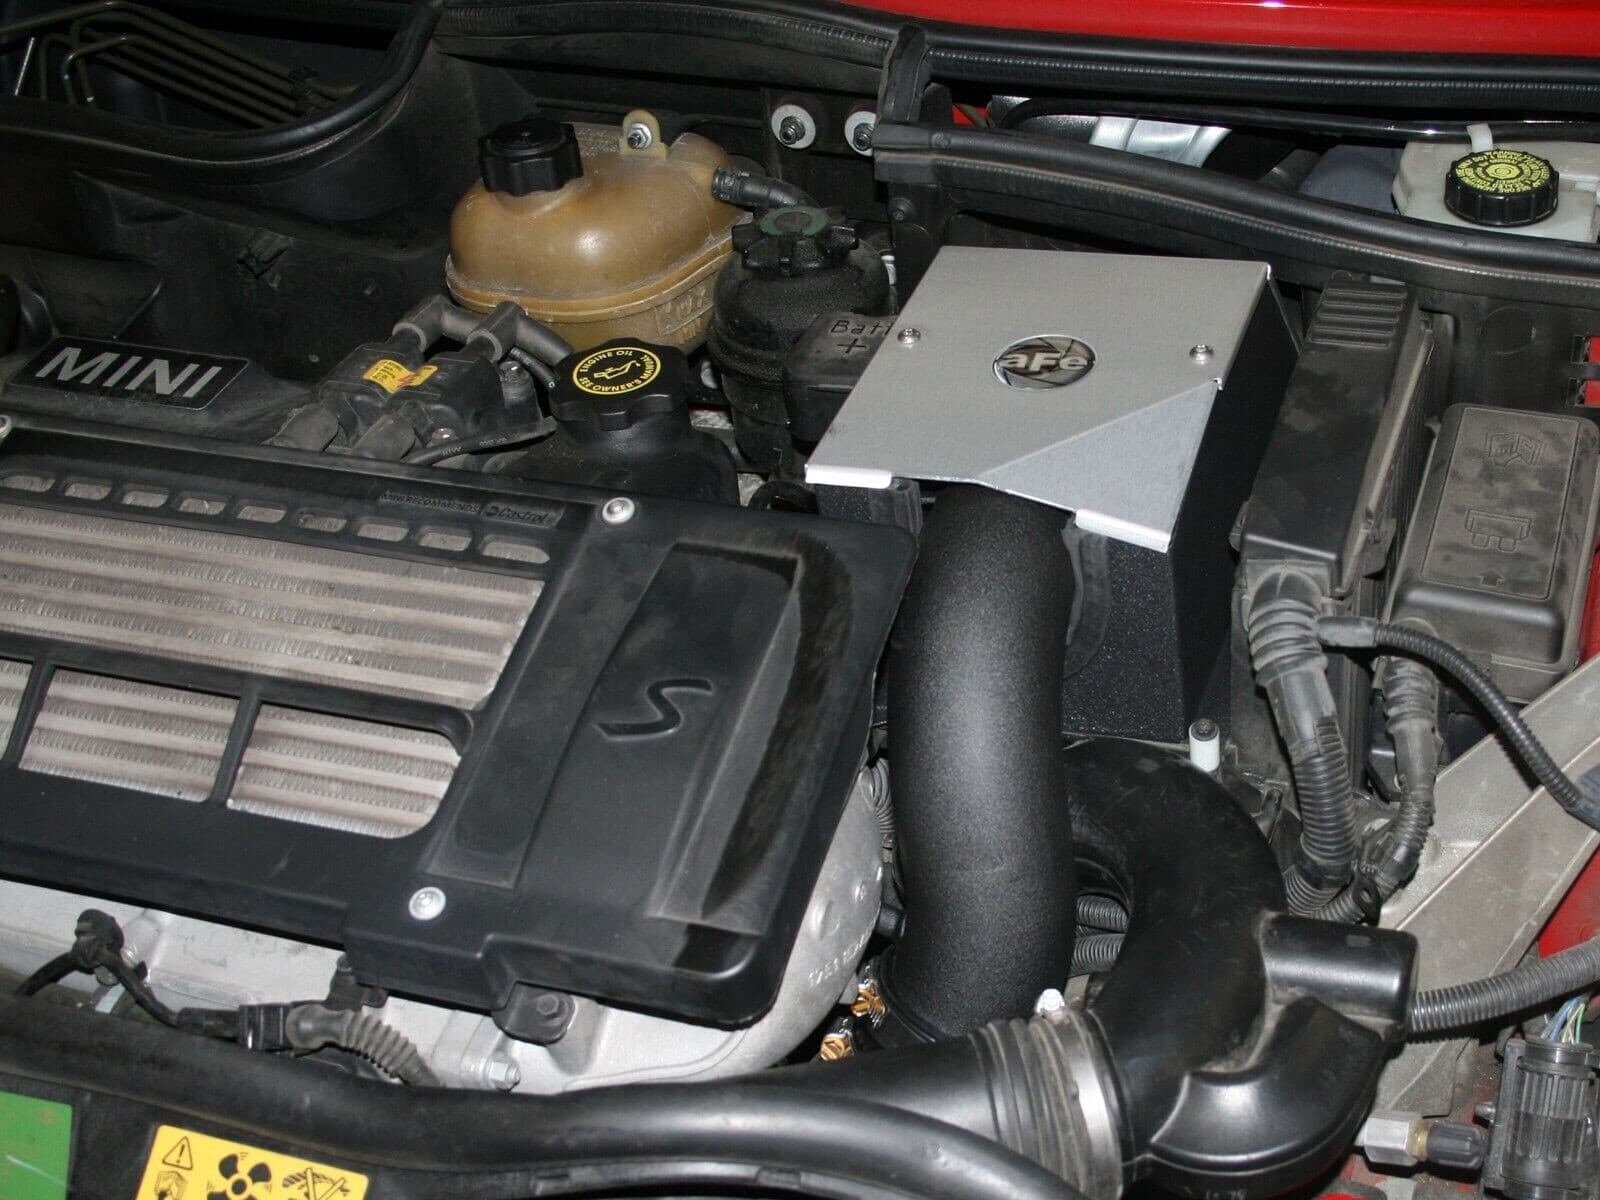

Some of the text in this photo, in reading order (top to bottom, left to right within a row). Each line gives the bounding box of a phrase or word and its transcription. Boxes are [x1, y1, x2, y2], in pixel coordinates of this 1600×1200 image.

[35, 346, 223, 398] MINI
[579, 355, 655, 392] SEE OWNER'S MANUAL
[580, 351, 613, 373] ENGINE
[999, 352, 1088, 372] aFe
[499, 506, 549, 524] Castrol
[593, 678, 713, 741] S
